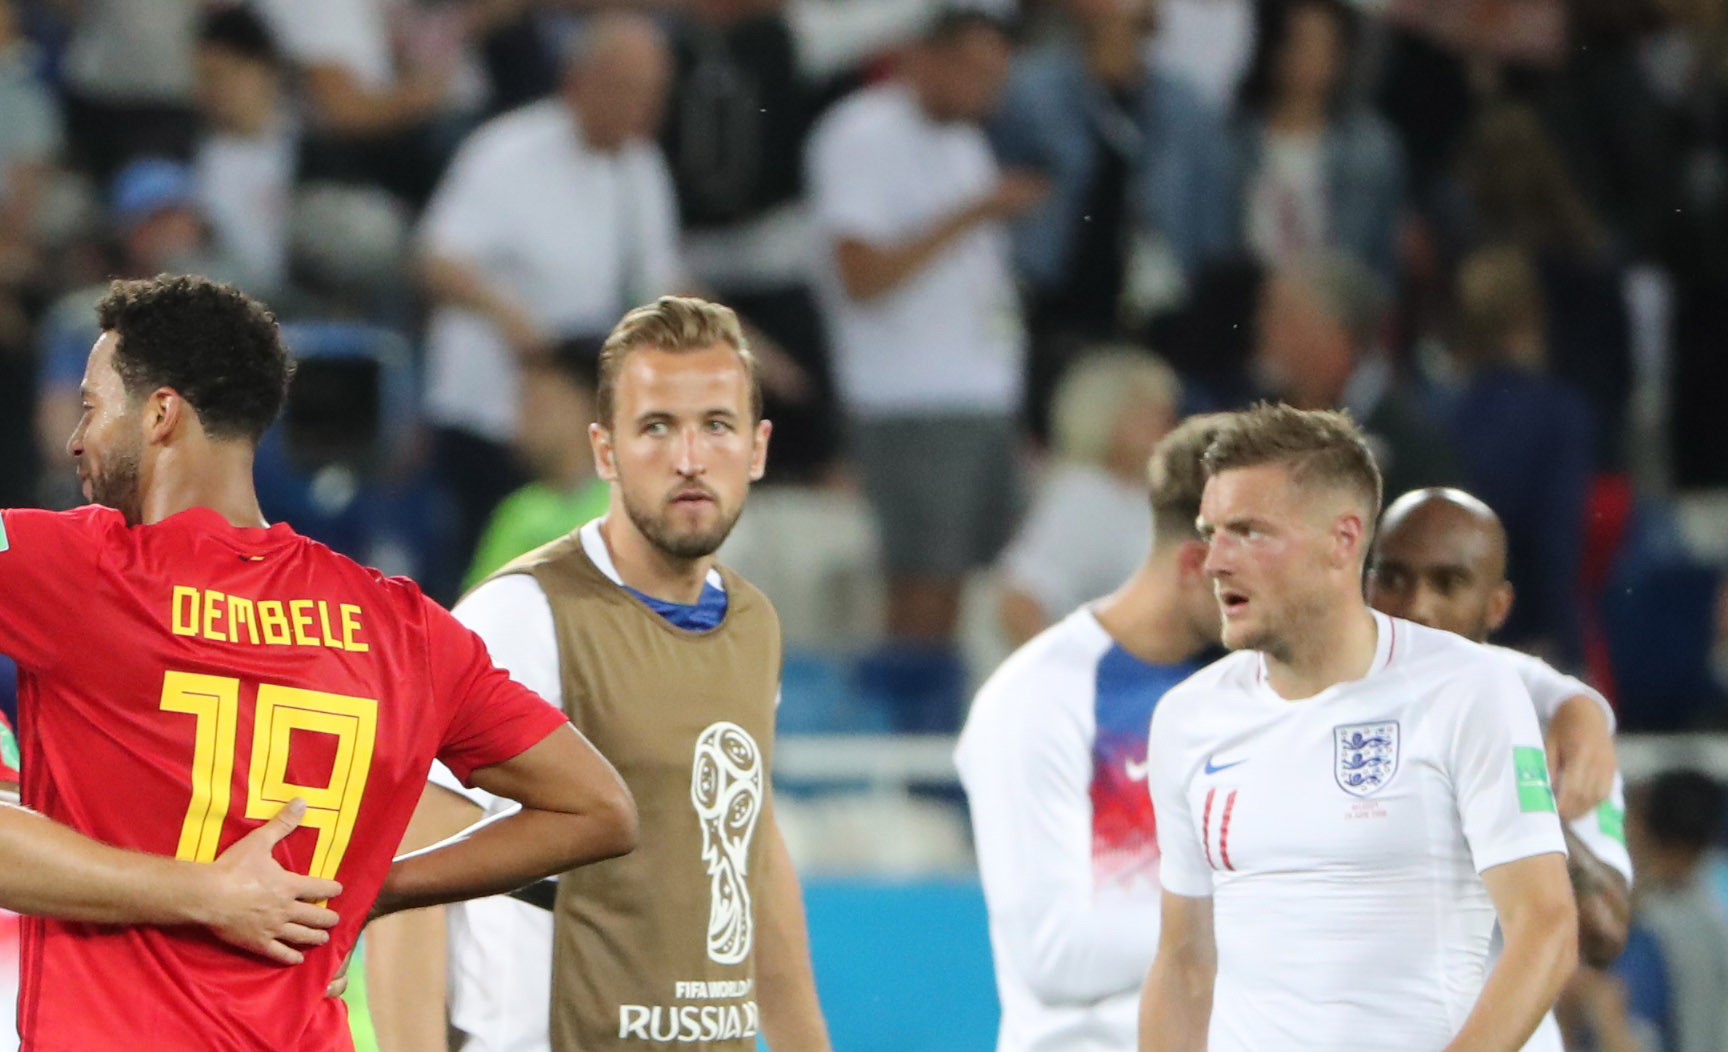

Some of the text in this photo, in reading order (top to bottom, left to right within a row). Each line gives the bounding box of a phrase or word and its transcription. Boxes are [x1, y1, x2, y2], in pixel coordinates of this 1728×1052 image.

[172, 585, 369, 652] DEMBELE
[159, 670, 378, 910] 19
[1202, 787, 1238, 871] 11
[618, 1004, 742, 1042] RUSSIA
[675, 981, 708, 999] FIFA
